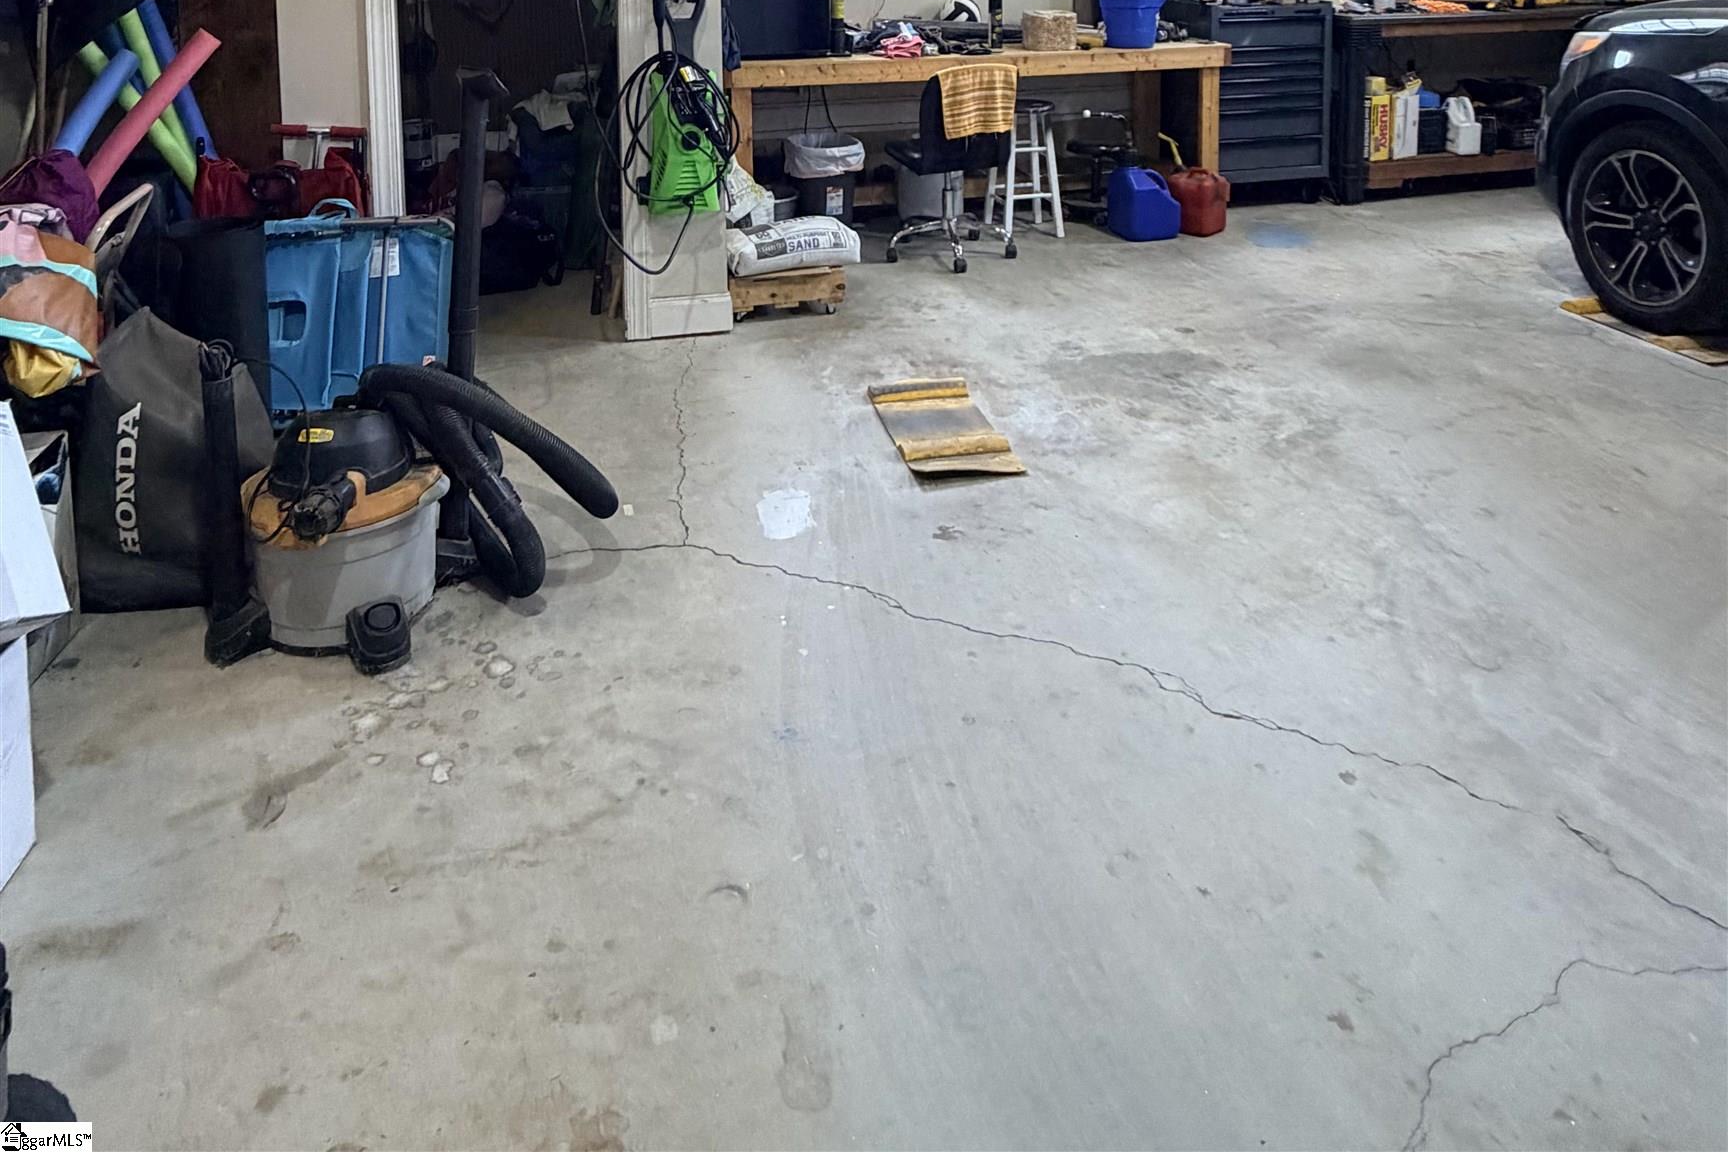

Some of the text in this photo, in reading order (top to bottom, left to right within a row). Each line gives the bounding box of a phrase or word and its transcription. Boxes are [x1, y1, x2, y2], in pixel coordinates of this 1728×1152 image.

[1380, 104, 1388, 148] HUSKY
[788, 238, 820, 252] SAND
[115, 402, 142, 555] HONDA
